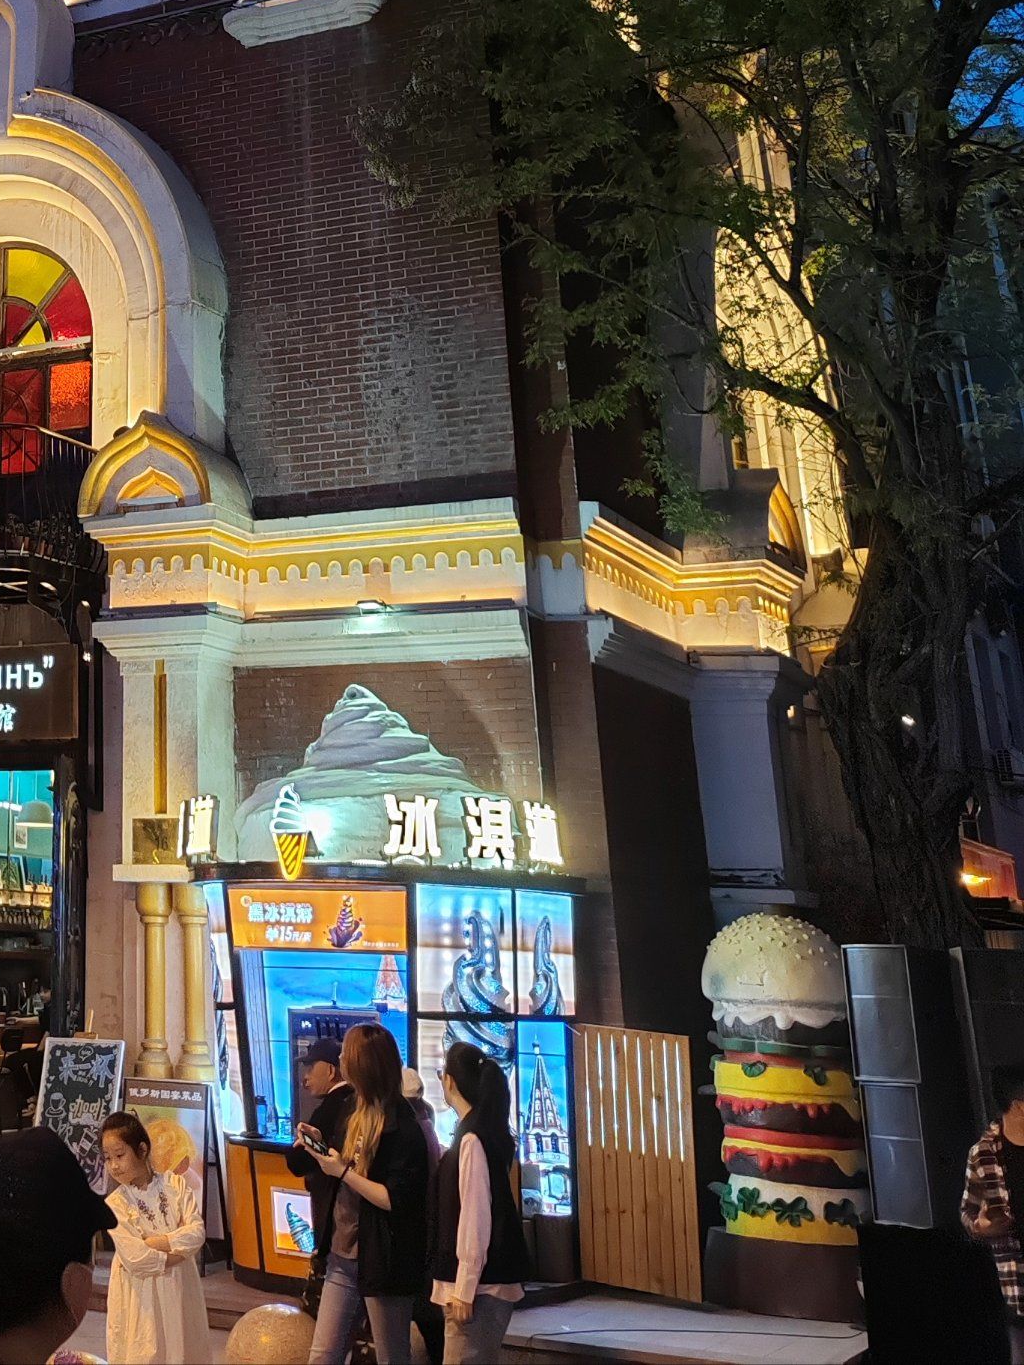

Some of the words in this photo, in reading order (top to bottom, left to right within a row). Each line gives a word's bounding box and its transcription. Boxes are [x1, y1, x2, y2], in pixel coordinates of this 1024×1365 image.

[247, 901, 314, 924] 黑冰淇淋
[59, 1051, 116, 1088] 来一杯
[69, 1094, 108, 1122] 咖啡
